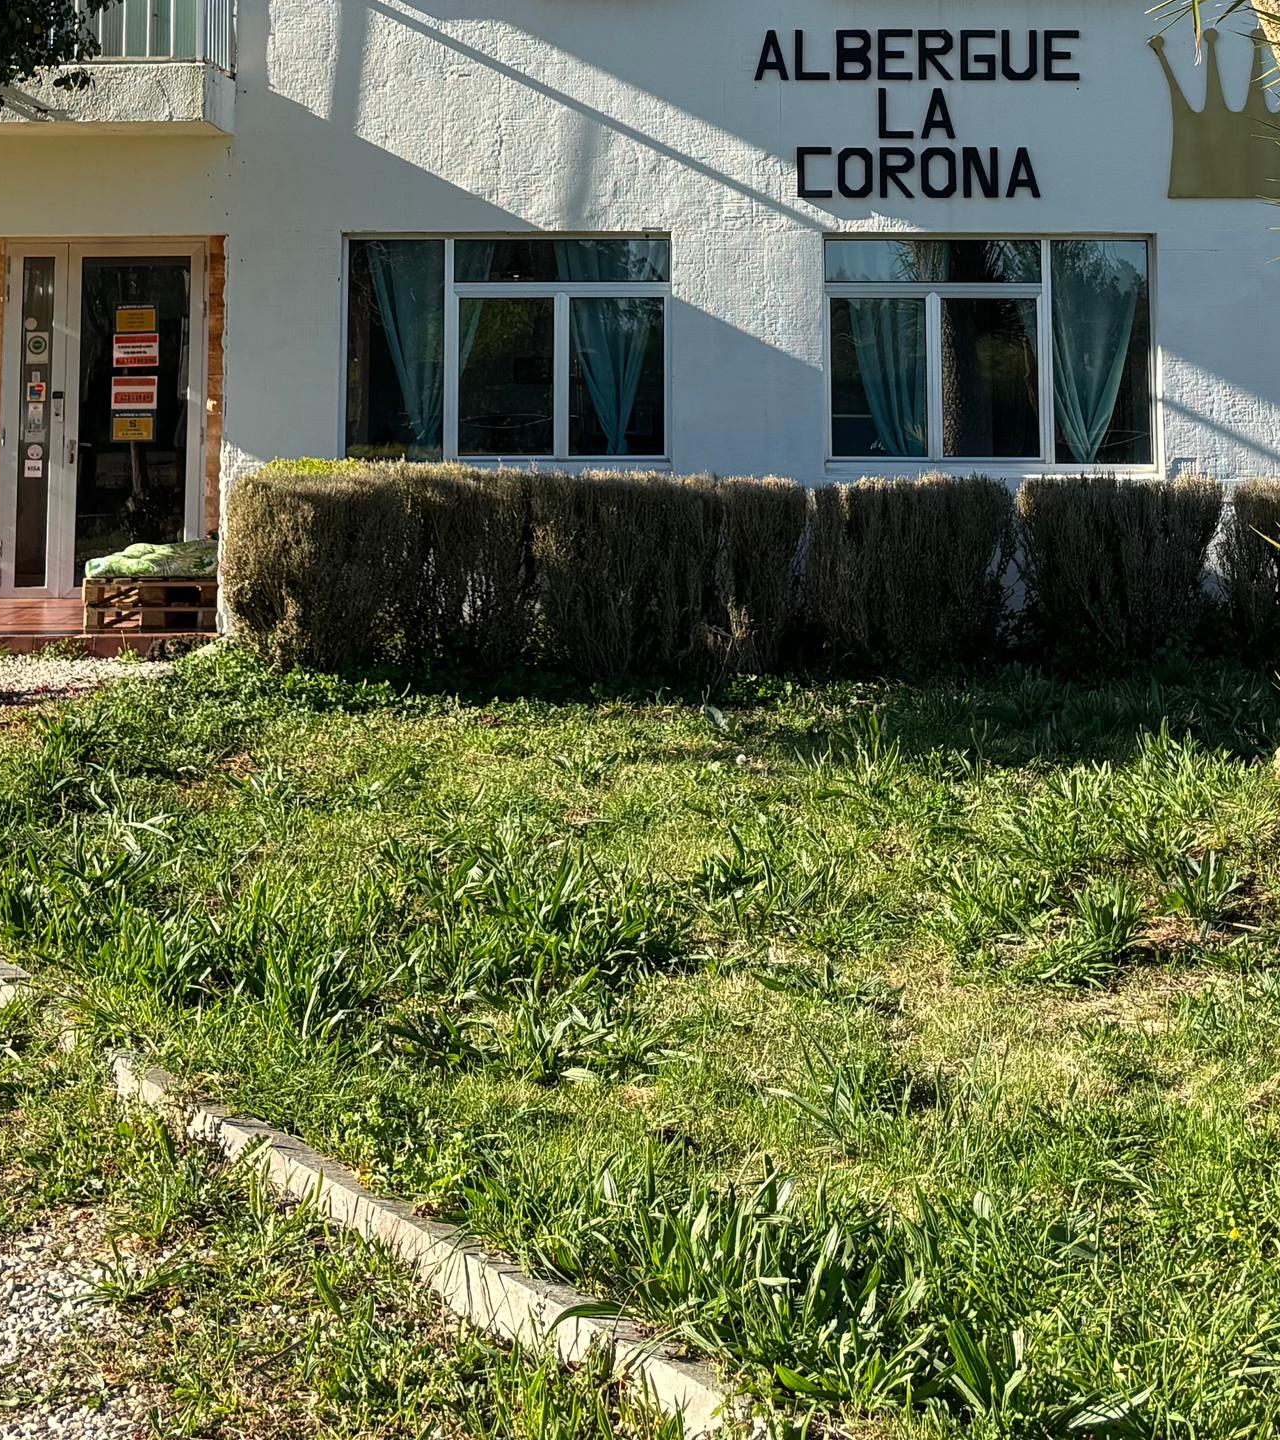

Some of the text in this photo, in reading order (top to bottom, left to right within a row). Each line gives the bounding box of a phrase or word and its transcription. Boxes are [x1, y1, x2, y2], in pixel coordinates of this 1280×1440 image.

[753, 29, 1080, 82] ALBERGUE
[878, 88, 956, 140] LA
[796, 147, 1041, 199] CORONA
